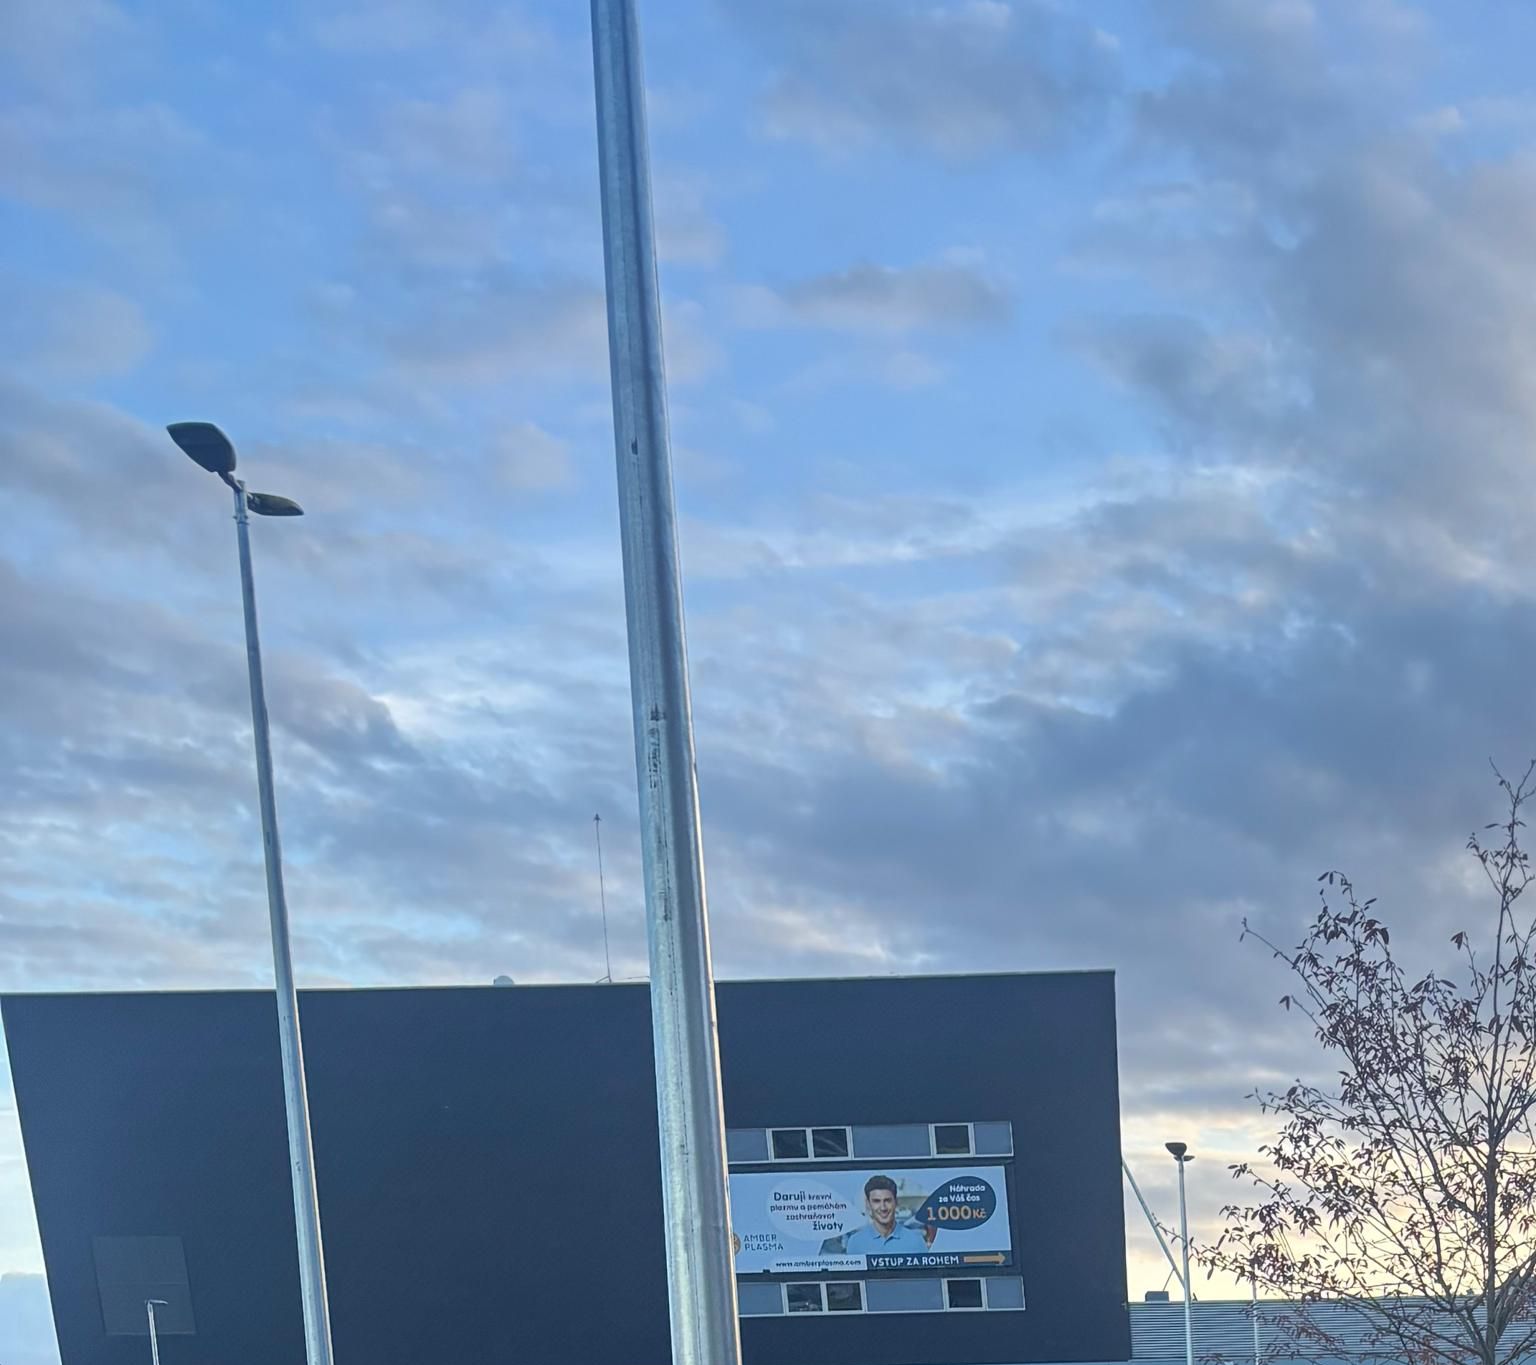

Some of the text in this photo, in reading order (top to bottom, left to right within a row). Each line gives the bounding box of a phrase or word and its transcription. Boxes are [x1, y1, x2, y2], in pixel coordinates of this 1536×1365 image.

[949, 1184, 986, 1193] Náhrada
[774, 1191, 806, 1203] Daruji
[949, 1194, 965, 1203] Váš
[972, 1208, 987, 1219] Kč
[812, 1221, 844, 1232] životy
[743, 1233, 777, 1242] AMBER
[744, 1243, 784, 1251] PLASMA
[775, 1260, 861, 1268] www.amberplasma.com
[871, 1255, 960, 1267] VSTUP ZA ROHEM
